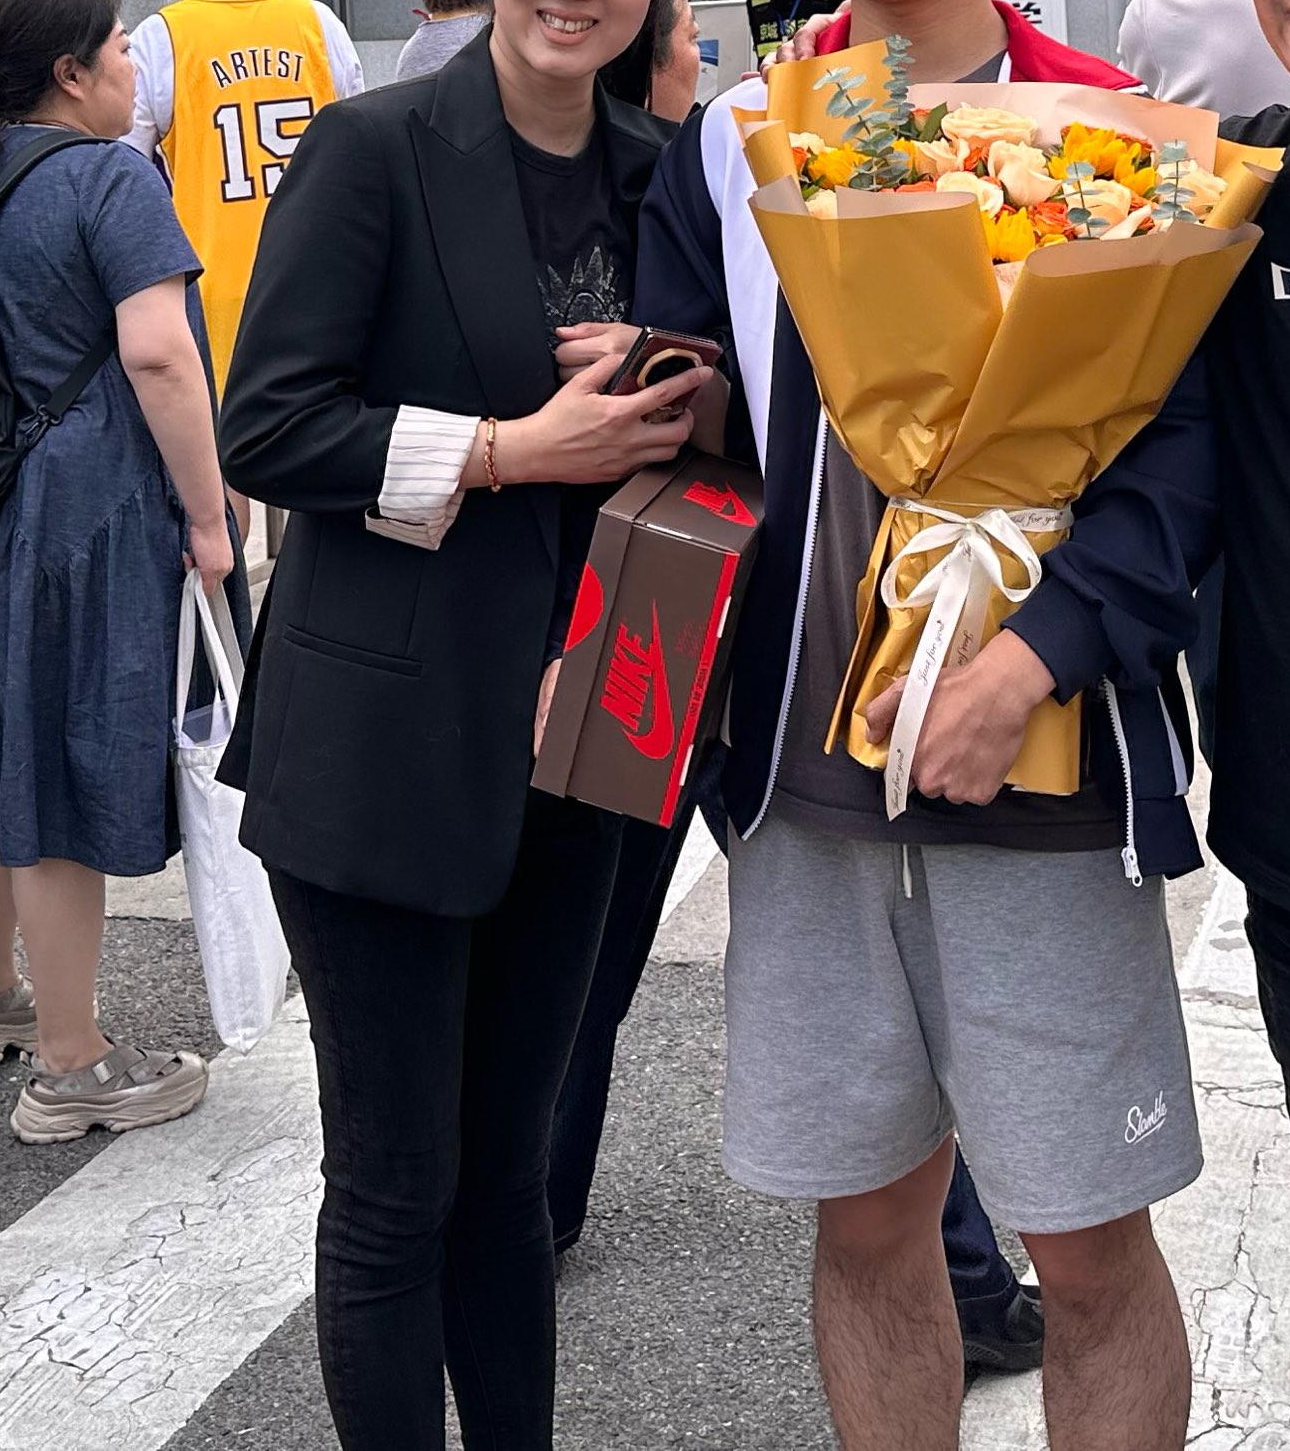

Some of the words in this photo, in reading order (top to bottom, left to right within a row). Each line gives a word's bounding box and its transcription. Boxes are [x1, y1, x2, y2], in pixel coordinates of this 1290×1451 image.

[211, 47, 304, 89] ARTEST
[213, 96, 315, 204] 15
[600, 622, 654, 733] NIKE
